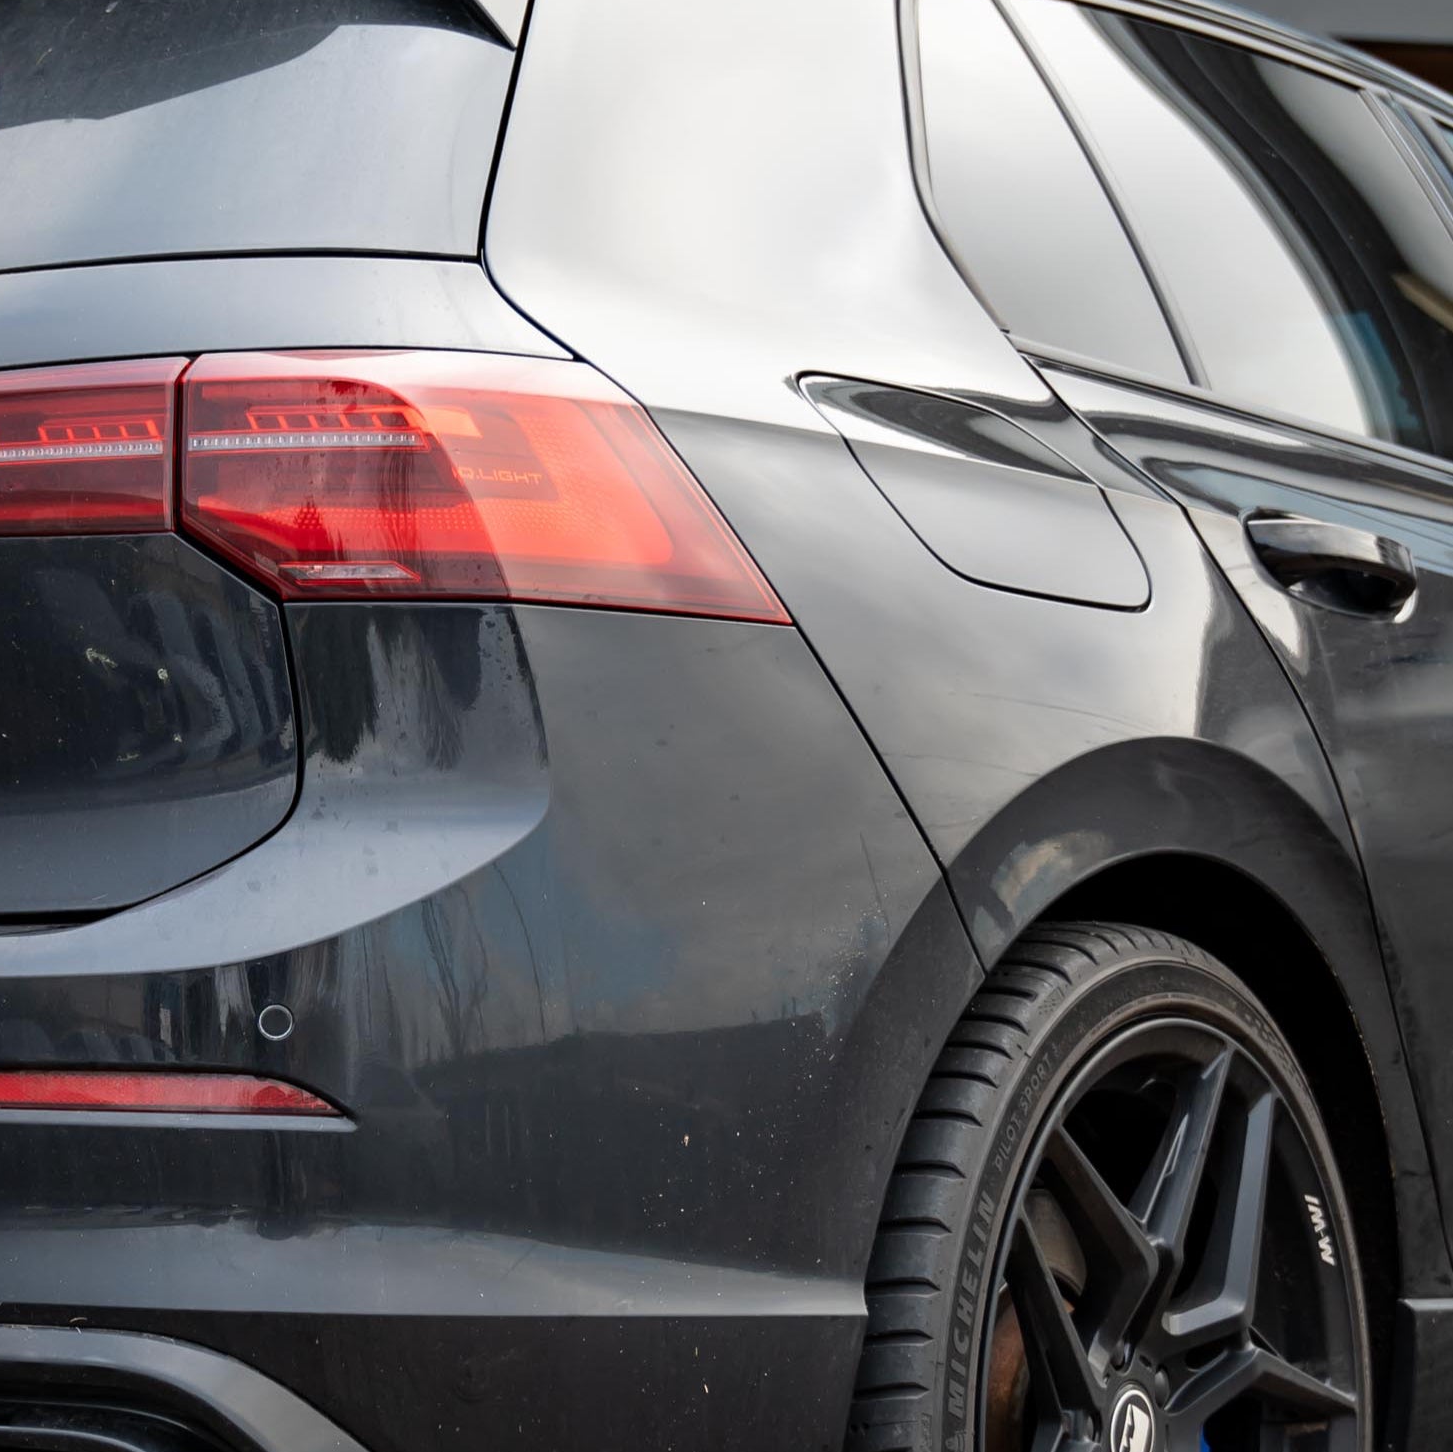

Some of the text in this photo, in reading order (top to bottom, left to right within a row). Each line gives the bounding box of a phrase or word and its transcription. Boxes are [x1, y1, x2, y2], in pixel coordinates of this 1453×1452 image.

[994, 1052, 1053, 1172] PILOT SPORT
[947, 1190, 997, 1421] MICHELIN
